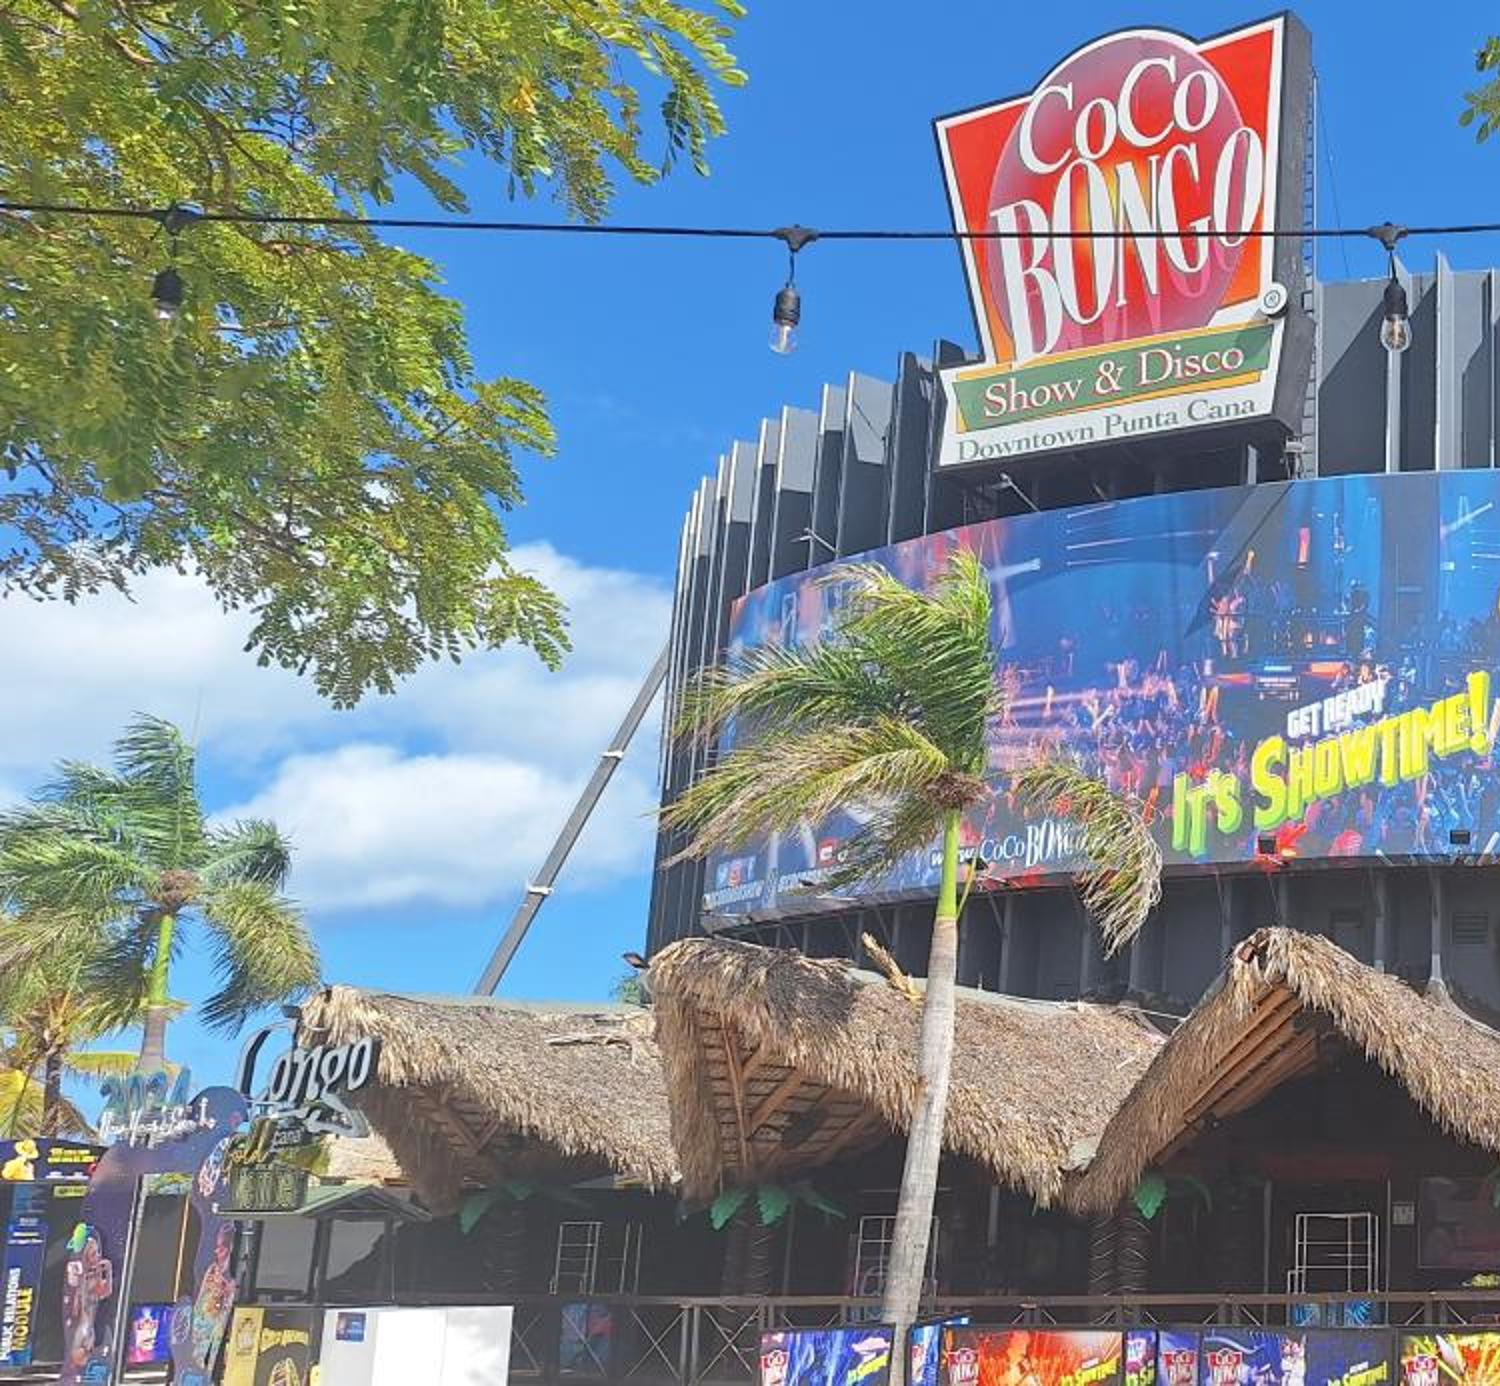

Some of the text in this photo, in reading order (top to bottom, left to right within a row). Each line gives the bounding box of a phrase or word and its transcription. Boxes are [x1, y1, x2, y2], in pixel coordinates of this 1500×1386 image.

[989, 127, 1263, 369] BONGO
[984, 345, 1244, 417] Show & Disco
[957, 399, 1255, 462] Downtown Punta Cana
[1288, 680, 1386, 738] GET READY
[11, 1287, 33, 1351] MODULE
